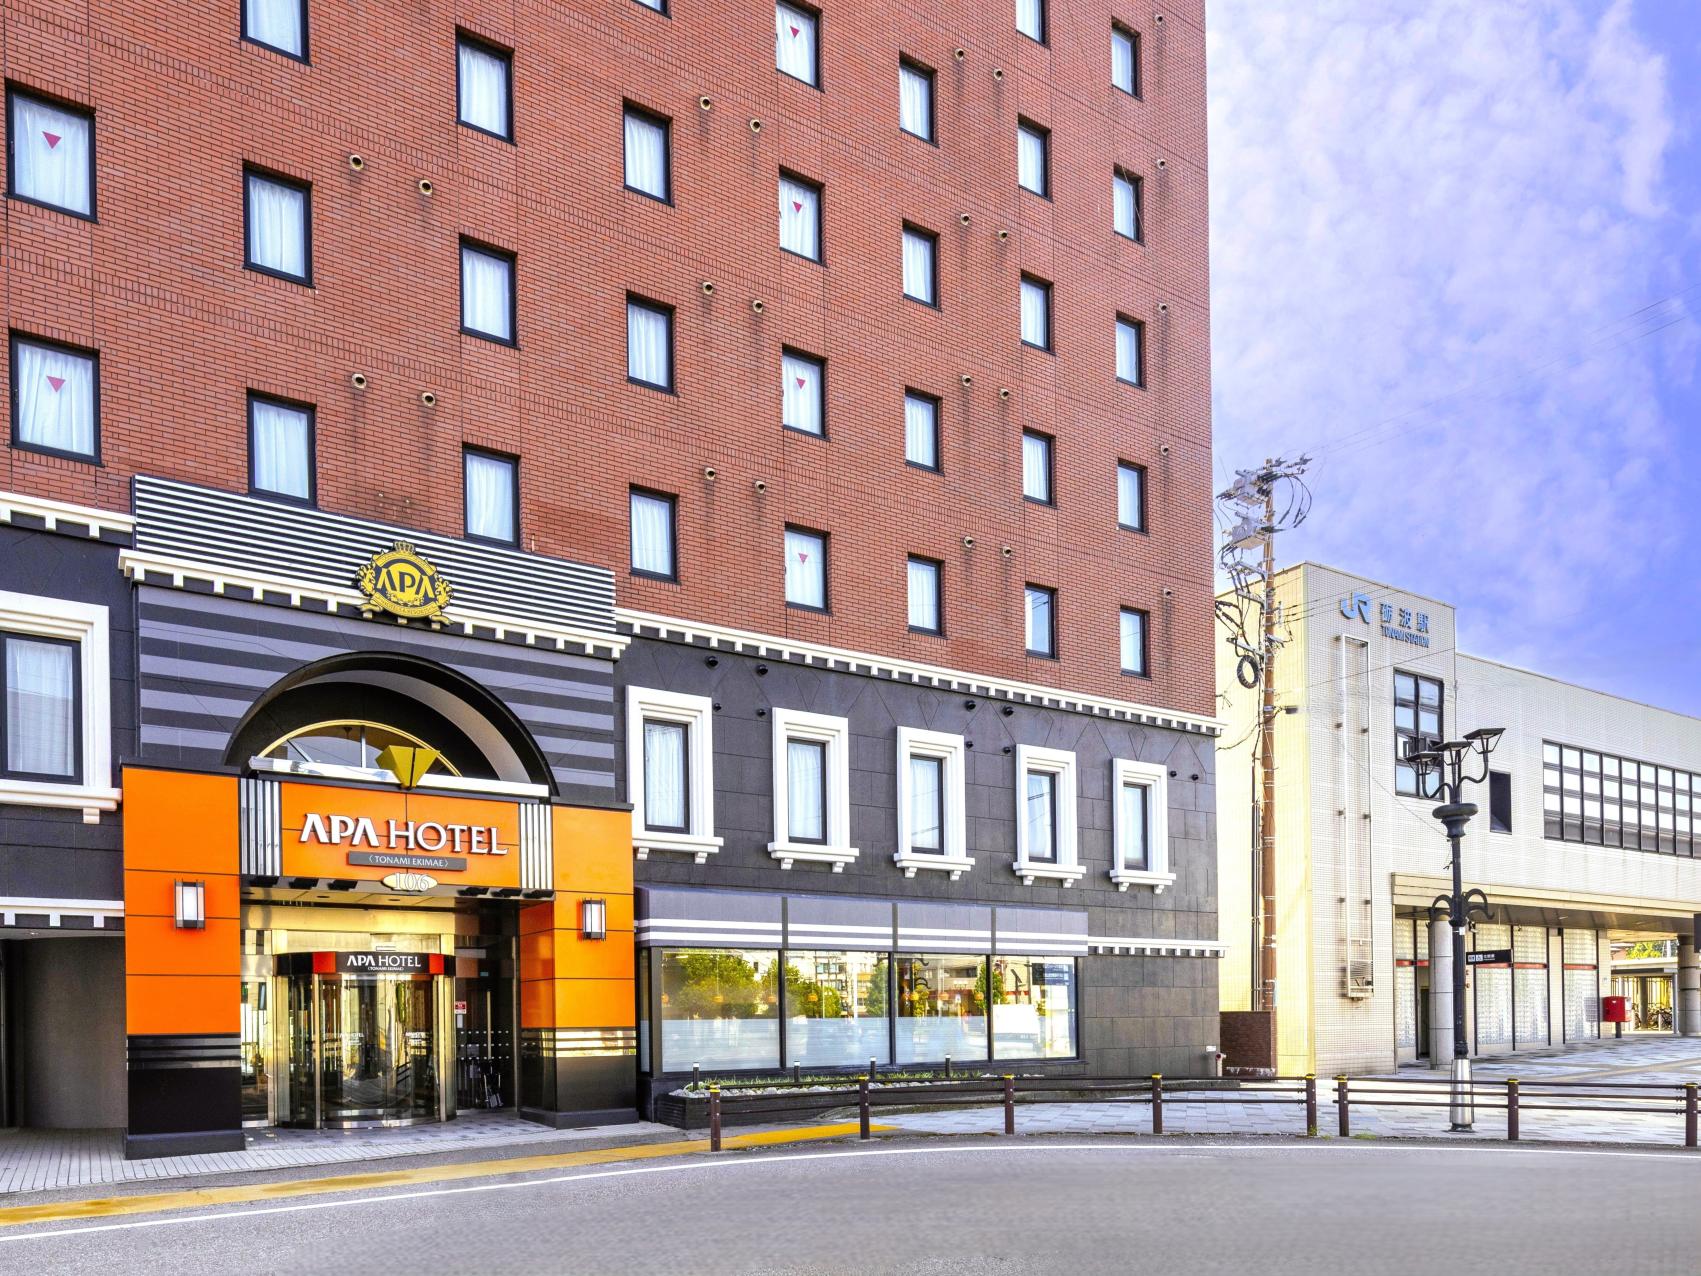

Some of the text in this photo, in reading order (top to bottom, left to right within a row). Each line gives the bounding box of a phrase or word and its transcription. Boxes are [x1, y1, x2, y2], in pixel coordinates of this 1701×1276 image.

[376, 569, 435, 598] APA
[1340, 591, 1371, 625] JR
[300, 813, 509, 855] APA HOTEL
[346, 955, 421, 967] APA HOTEL
